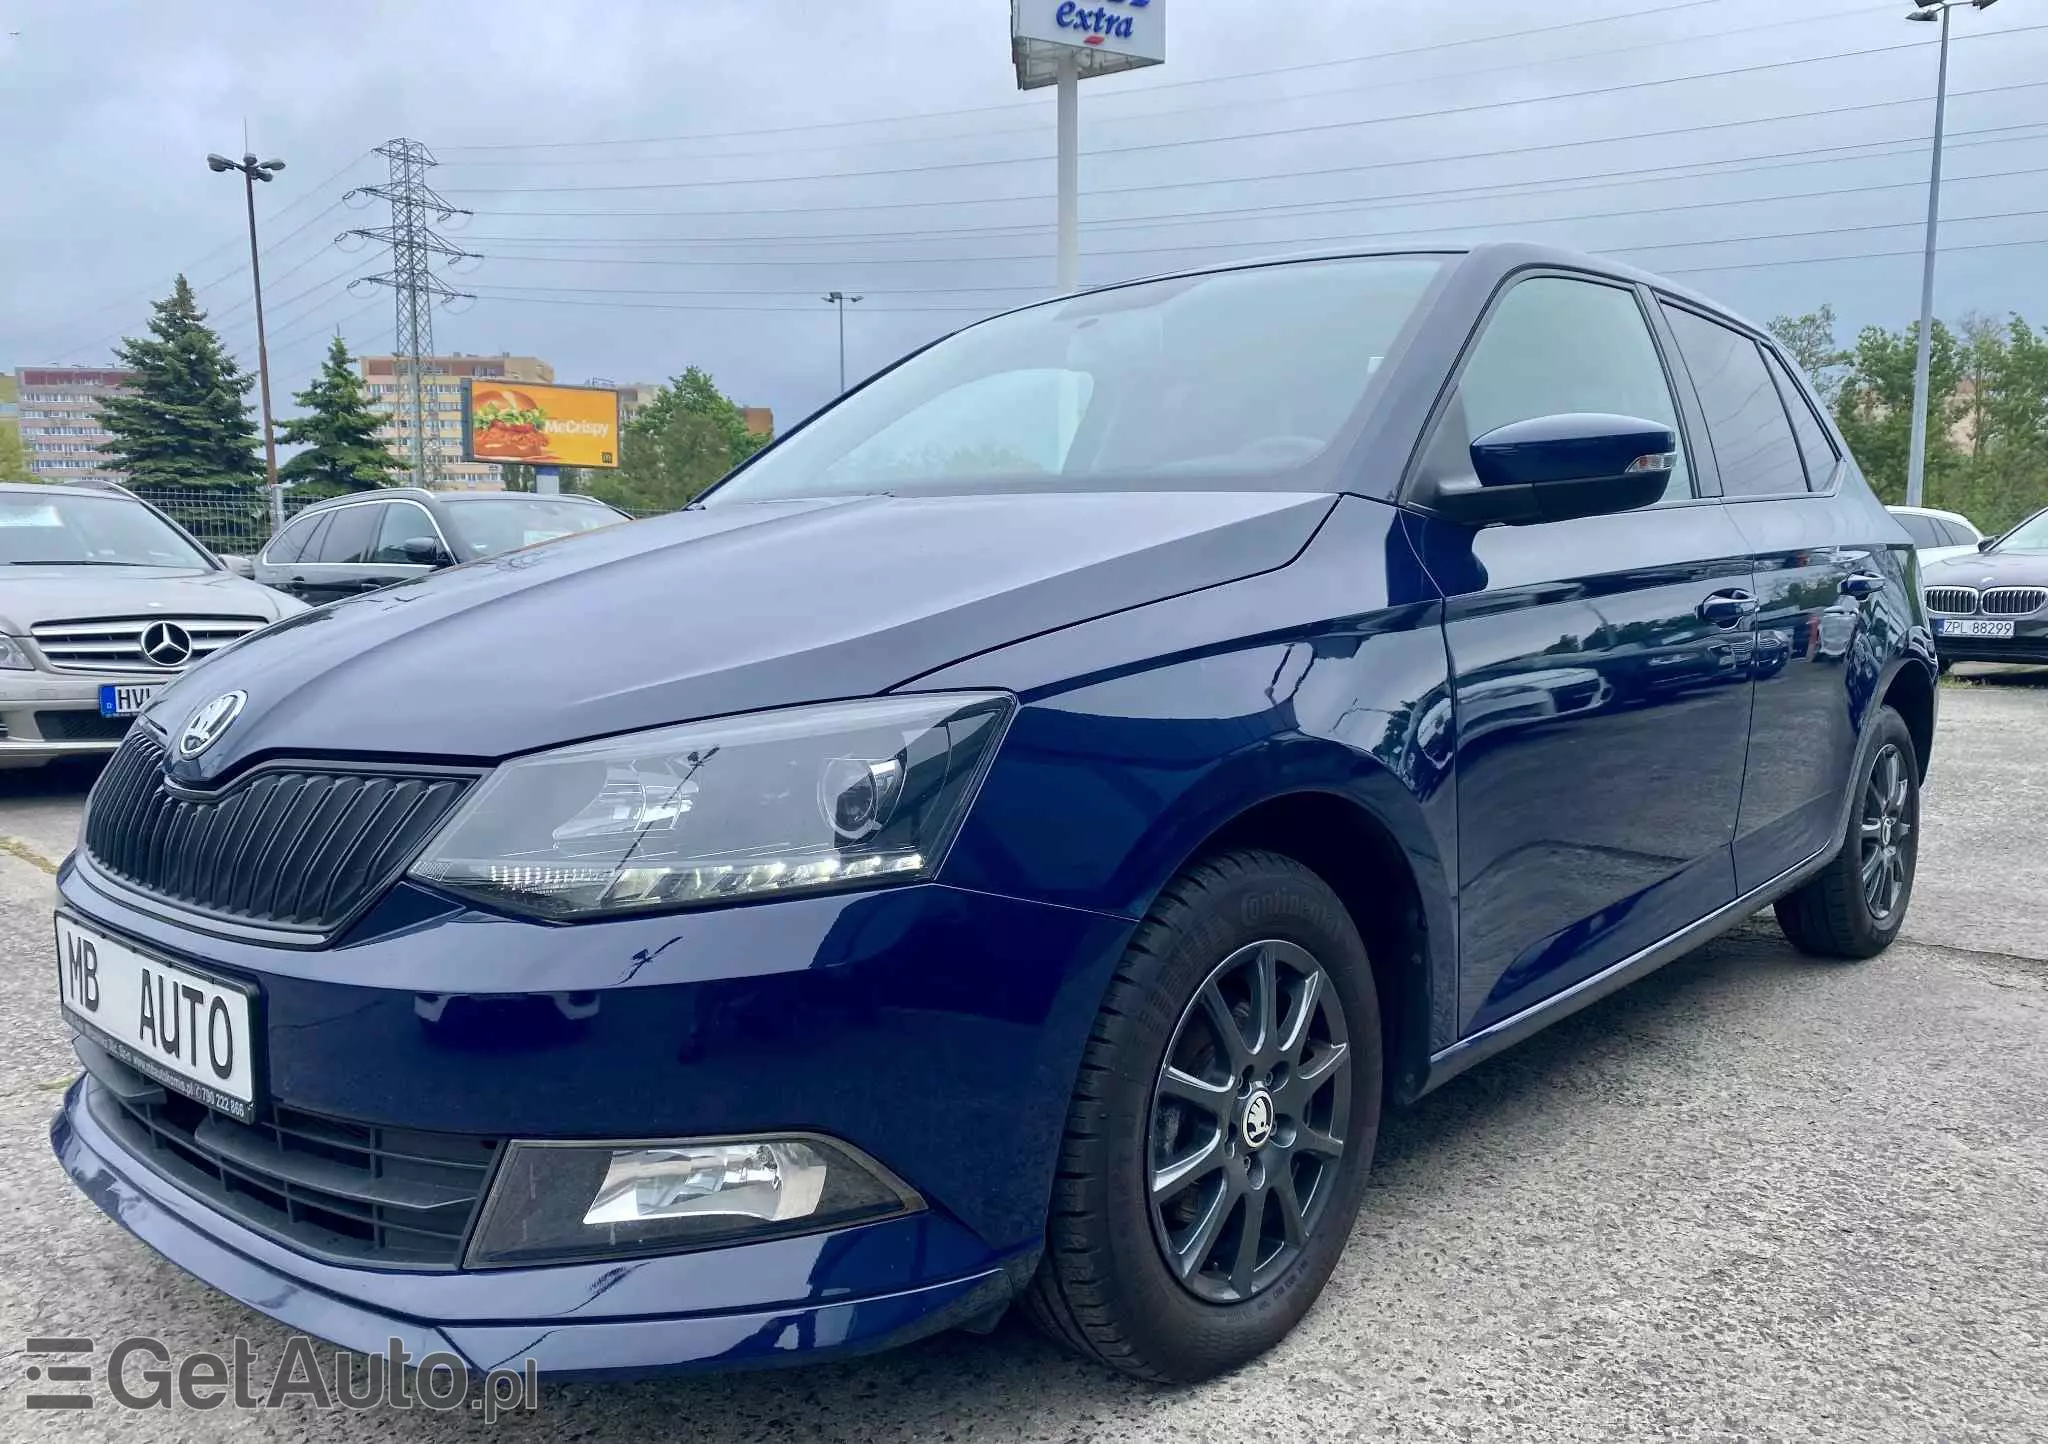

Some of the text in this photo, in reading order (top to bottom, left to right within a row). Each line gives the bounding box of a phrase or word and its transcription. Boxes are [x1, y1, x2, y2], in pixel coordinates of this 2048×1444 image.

[1056, 1, 1134, 38] extra
[544, 419, 609, 437] McCrispy
[1944, 621, 2012, 634] ZPL 88299
[67, 931, 100, 1013] MB
[139, 967, 233, 1080] AUTO
[216, 1093, 229, 1112] 222
